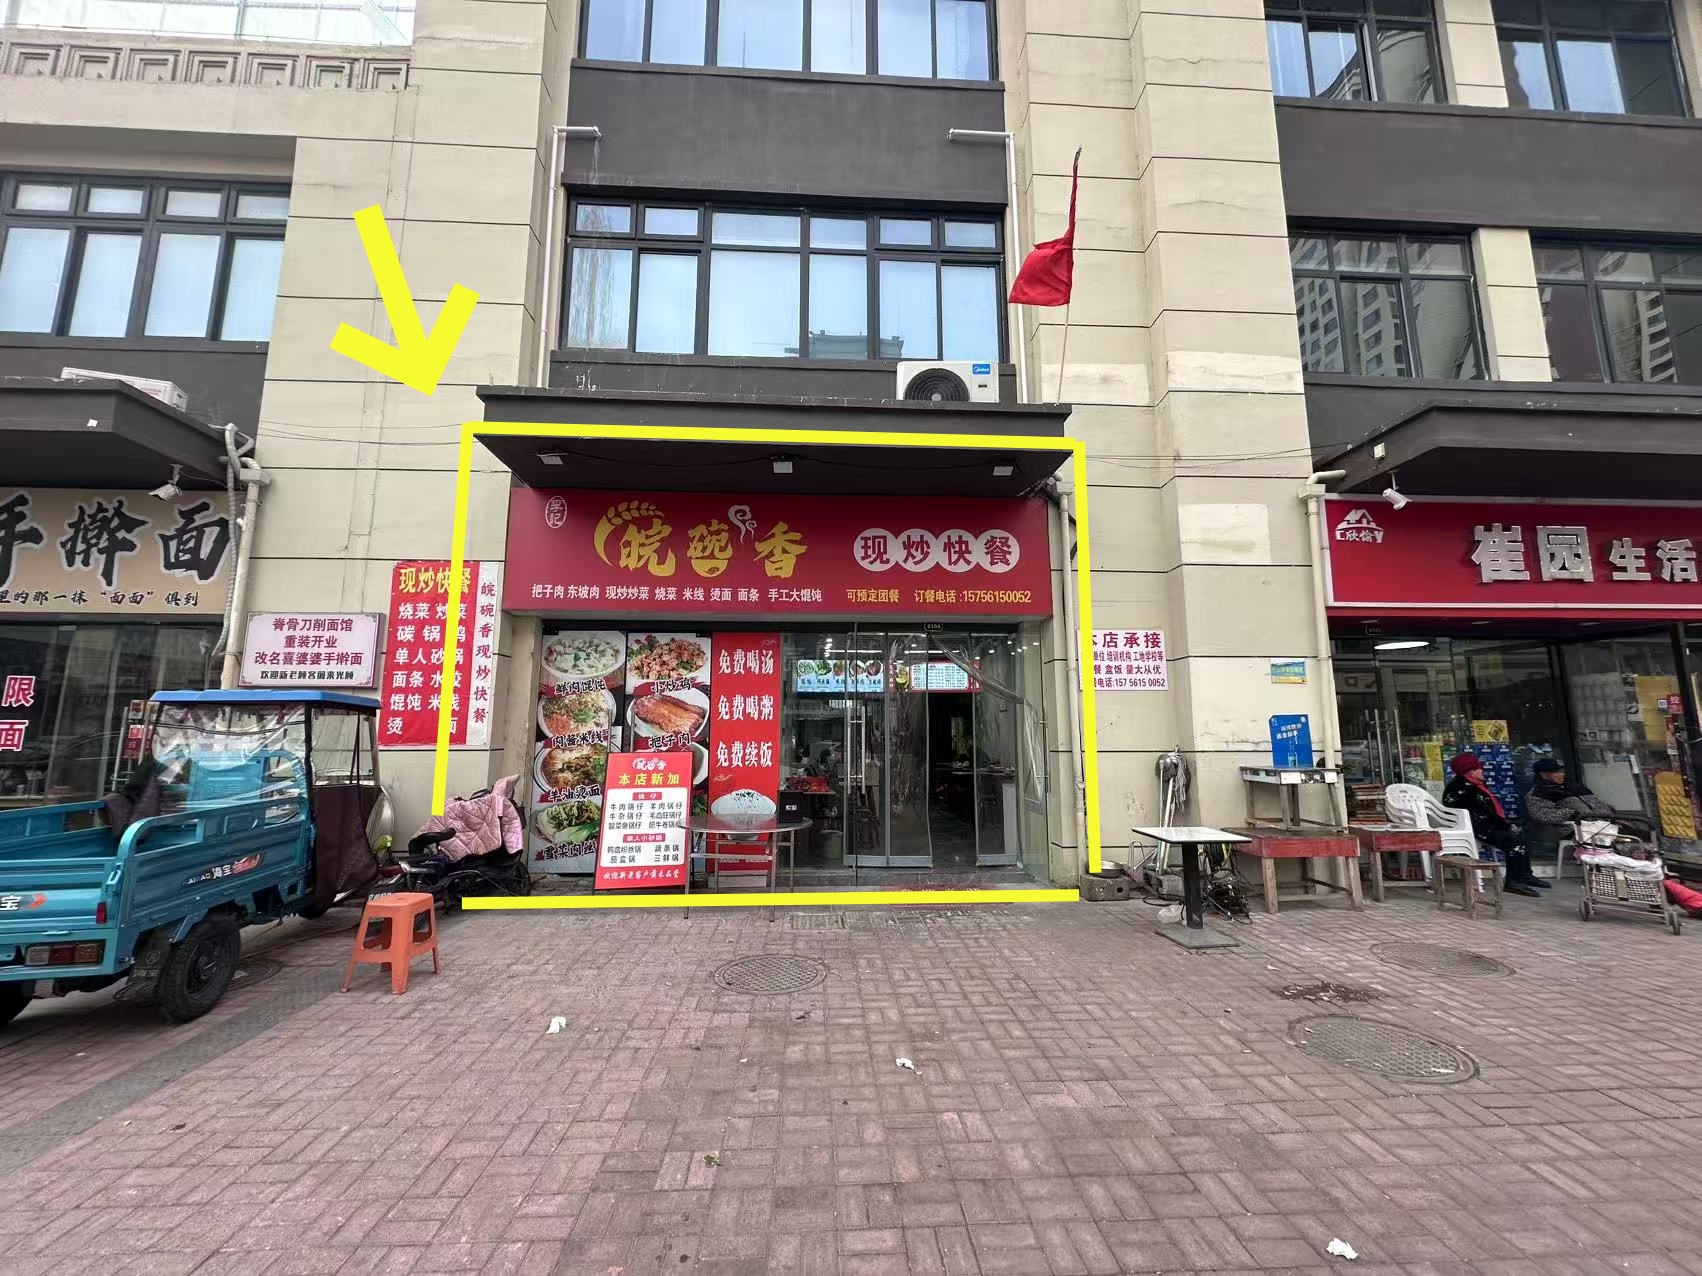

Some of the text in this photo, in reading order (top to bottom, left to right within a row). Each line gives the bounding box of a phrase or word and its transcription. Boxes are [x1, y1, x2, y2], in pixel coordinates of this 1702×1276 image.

[860, 534, 1013, 567] 现炒快餐
[165, 591, 199, 607] 俱到
[531, 583, 823, 603] 把子肉 东坡肉 现炒炒菜 烧菜 米线 烫面 面条 手工大馄饨
[846, 589, 900, 603] 可预定团餐
[398, 602, 430, 619] 烧菜
[273, 618, 354, 632] 脊骨刀削面馆
[283, 634, 338, 649] 重装开业
[1092, 632, 1162, 648] 店承接
[254, 651, 364, 666] 改名喜婆婆手擀面
[718, 649, 774, 675] 免费喝汤
[1126, 665, 1162, 675] 量大从优
[392, 671, 424, 688] 面条
[651, 677, 691, 693] 小炒鸡
[1094, 678, 1127, 688] 电话:157
[1148, 678, 1165, 687] 0052
[1, 675, 36, 707] 限
[390, 694, 422, 711] 馄饨
[717, 694, 774, 720] 免费喝粥
[649, 732, 692, 749] 把子肉
[715, 741, 773, 768] 免费续饭
[618, 773, 680, 786] 本店新加
[610, 803, 644, 811] 牛肉锅仔
[543, 841, 600, 861] 雪菜肉丝
